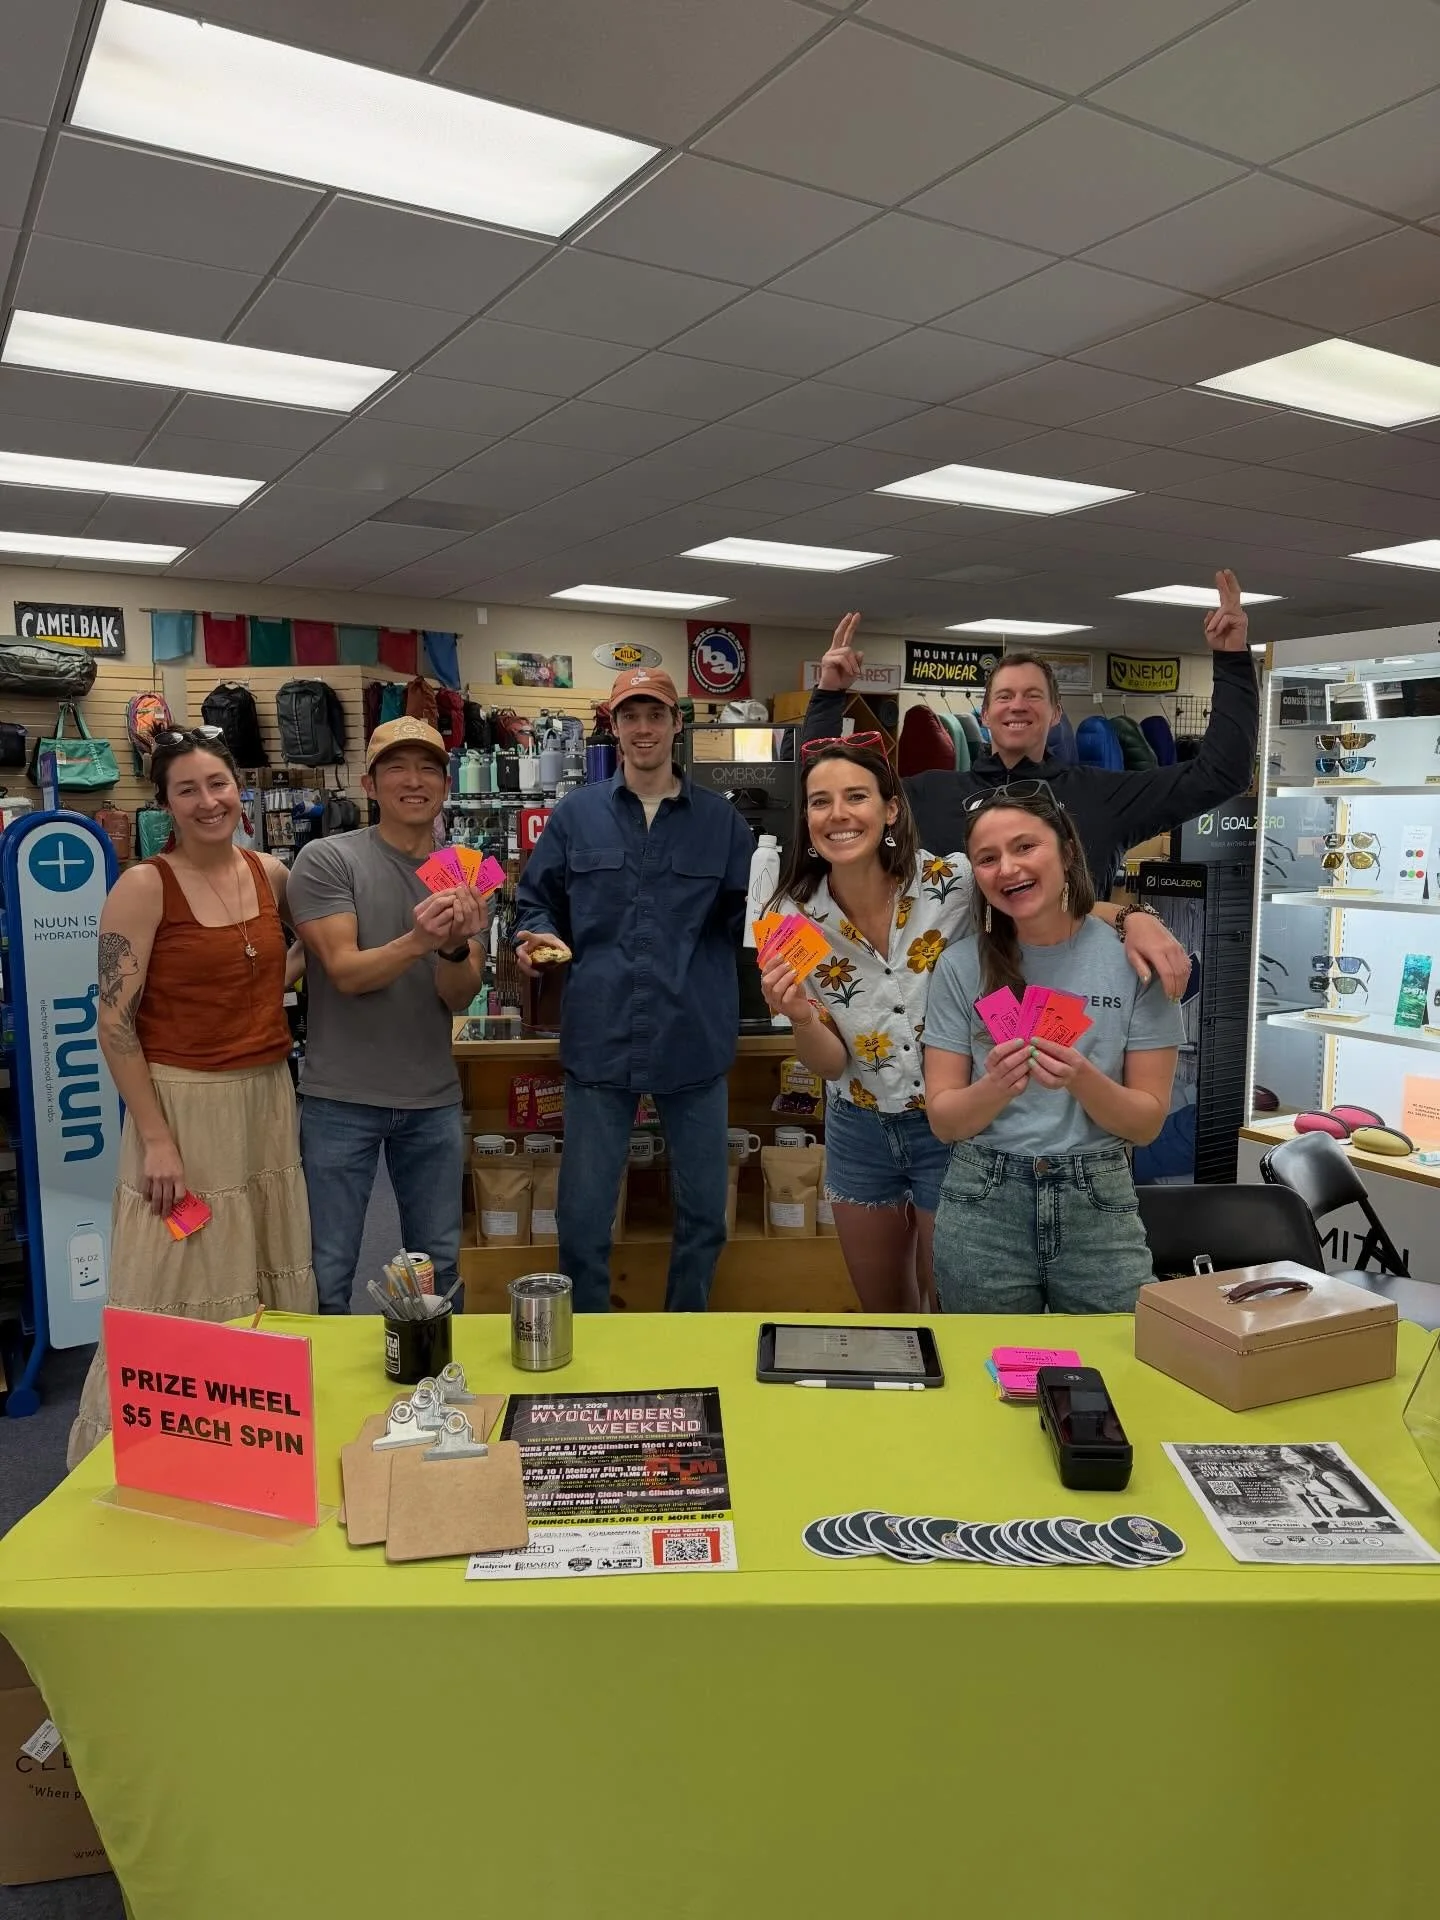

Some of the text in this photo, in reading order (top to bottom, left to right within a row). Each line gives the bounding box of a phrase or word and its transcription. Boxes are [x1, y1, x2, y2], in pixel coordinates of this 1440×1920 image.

[21, 612, 118, 648] CAMELBAK
[620, 650, 637, 659] ATLAS
[913, 649, 978, 661] MOUNTAIN
[912, 662, 977, 681] HARDWEAR
[1130, 664, 1173, 679] NEMO
[1160, 878, 1203, 888] GOALZERO
[33, 914, 98, 929] NUUN IS
[34, 930, 98, 941] HYDRATION
[1085, 995, 1122, 1009] ERS
[40, 999, 50, 1040] electrolyte
[43, 1041, 53, 1081] enhanced
[52, 985, 105, 1163] nuun
[45, 1083, 54, 1103] drink
[121, 1367, 301, 1416] PRIZE WHEEL
[531, 1407, 686, 1423] WYOCLIMBERS
[122, 1403, 304, 1455] $5 EACH SPIN
[587, 1420, 701, 1435] WEEKEND
[1200, 1470, 1235, 1478] SWAG
[555, 1492, 596, 1500] Highway
[597, 1490, 638, 1498] Clean-Up
[648, 1488, 685, 1497] Climber
[686, 1487, 725, 1496] Meet-Up
[526, 1515, 640, 1525] YOMINGCLIMBERS.ORG
